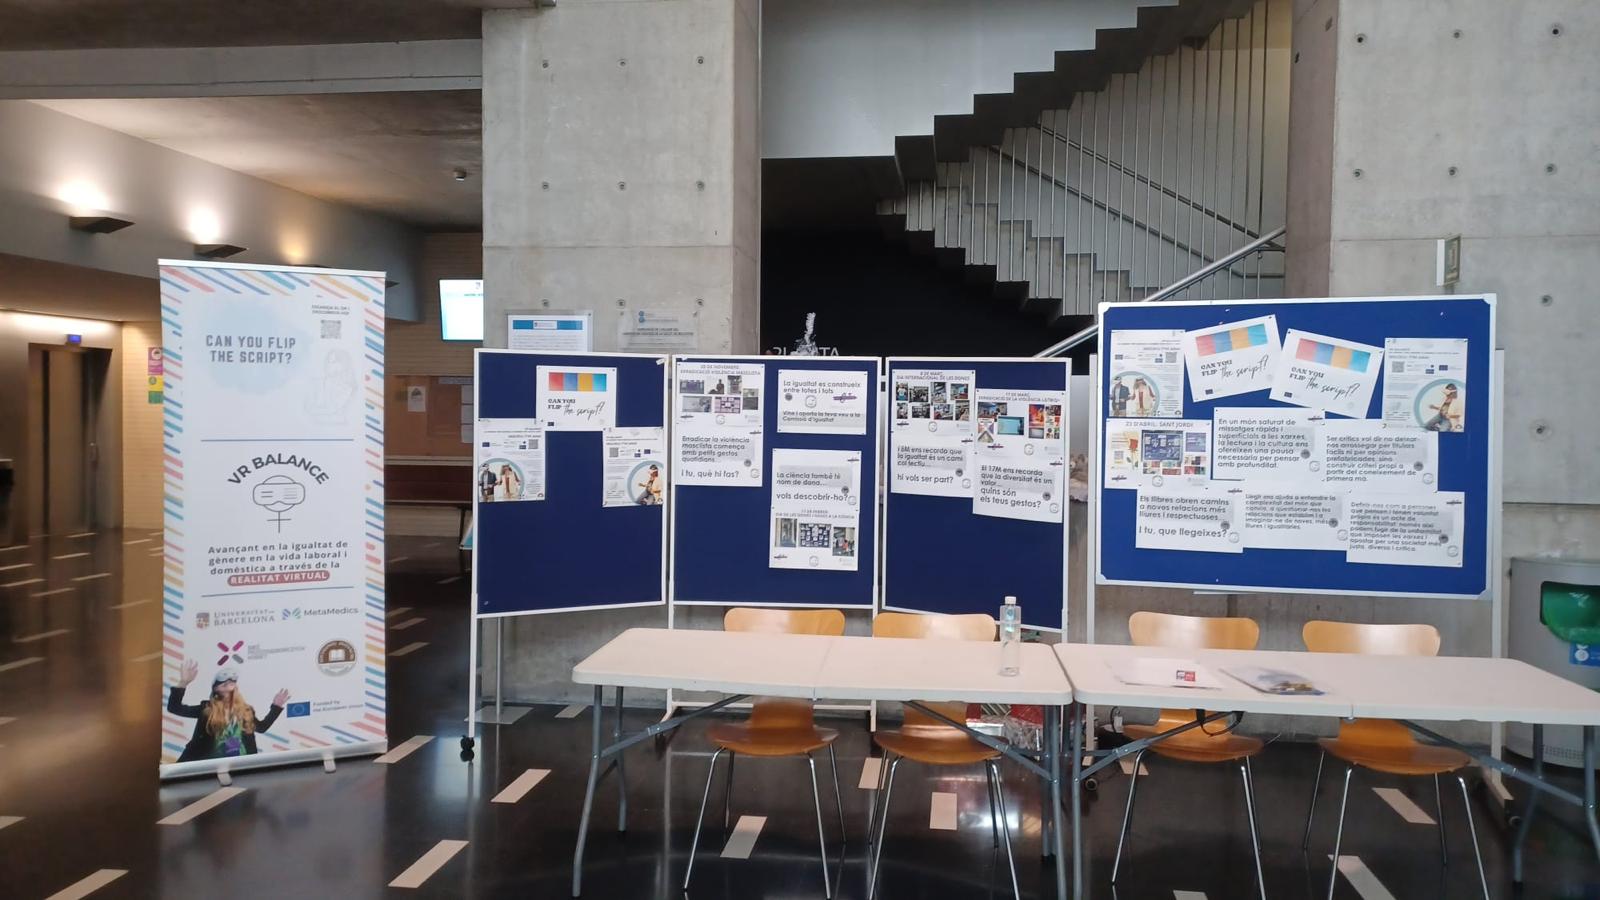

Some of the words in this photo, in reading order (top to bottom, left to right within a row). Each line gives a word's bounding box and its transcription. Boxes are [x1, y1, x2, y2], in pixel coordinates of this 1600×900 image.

[206, 334, 232, 347] CAN
[238, 336, 262, 348] YOU
[268, 337, 296, 349] FLIP
[211, 350, 234, 362] THE
[240, 351, 292, 364] SCRIPT?
[228, 464, 252, 486] VR
[252, 453, 330, 484] BALANCE
[1002, 488, 1016, 496] són
[992, 496, 1008, 504] teus
[1010, 499, 1042, 507] gestos?
[1145, 526, 1156, 534] tu,
[1179, 528, 1228, 537] llegeixes?
[208, 544, 258, 554] Avançant
[292, 541, 332, 552] igualtat
[209, 556, 246, 566] gènere
[266, 554, 276, 562] la
[279, 553, 301, 561] vida
[304, 551, 341, 560] laboral
[210, 564, 266, 576] domèstica
[279, 562, 312, 572] través
[315, 561, 328, 570] de
[230, 574, 280, 584] REALITAT
[282, 572, 328, 582] VIRTUAL
[304, 607, 359, 616] MetaMedics
[214, 616, 275, 626] BARCELONA
